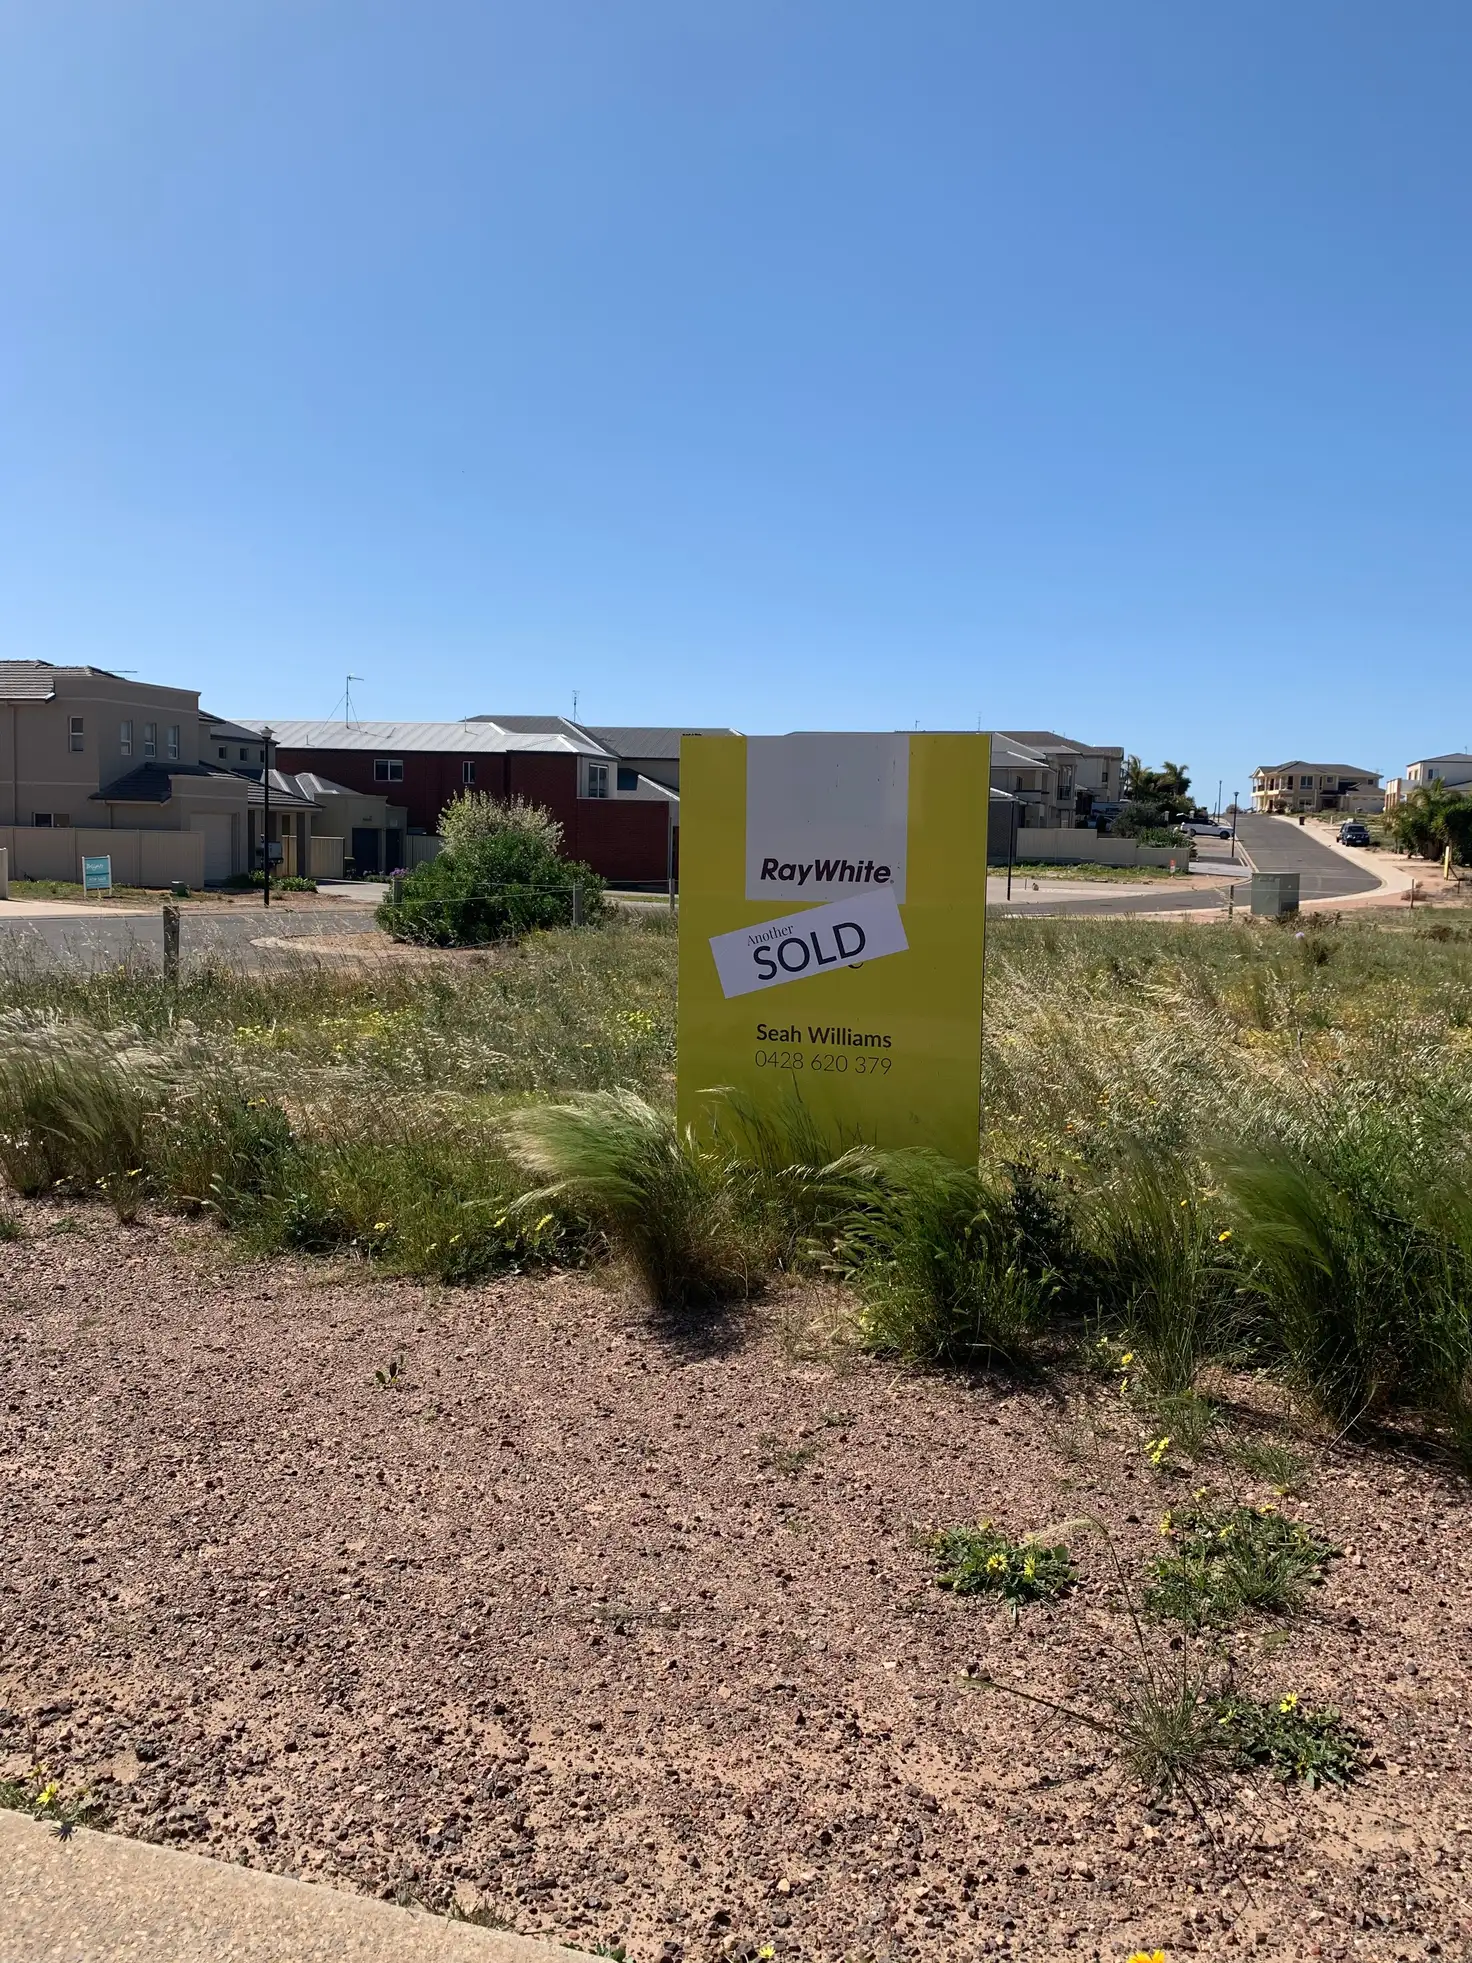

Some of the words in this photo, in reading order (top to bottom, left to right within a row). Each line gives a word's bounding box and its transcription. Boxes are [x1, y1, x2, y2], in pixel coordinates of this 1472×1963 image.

[747, 925, 794, 946] Another
[753, 922, 866, 980] SOLD
[756, 1023, 801, 1043] Seah
[807, 1026, 892, 1048] Williams
[755, 1050, 804, 1070] 0428
[810, 1053, 848, 1073] 620
[854, 1056, 892, 1075] 379
